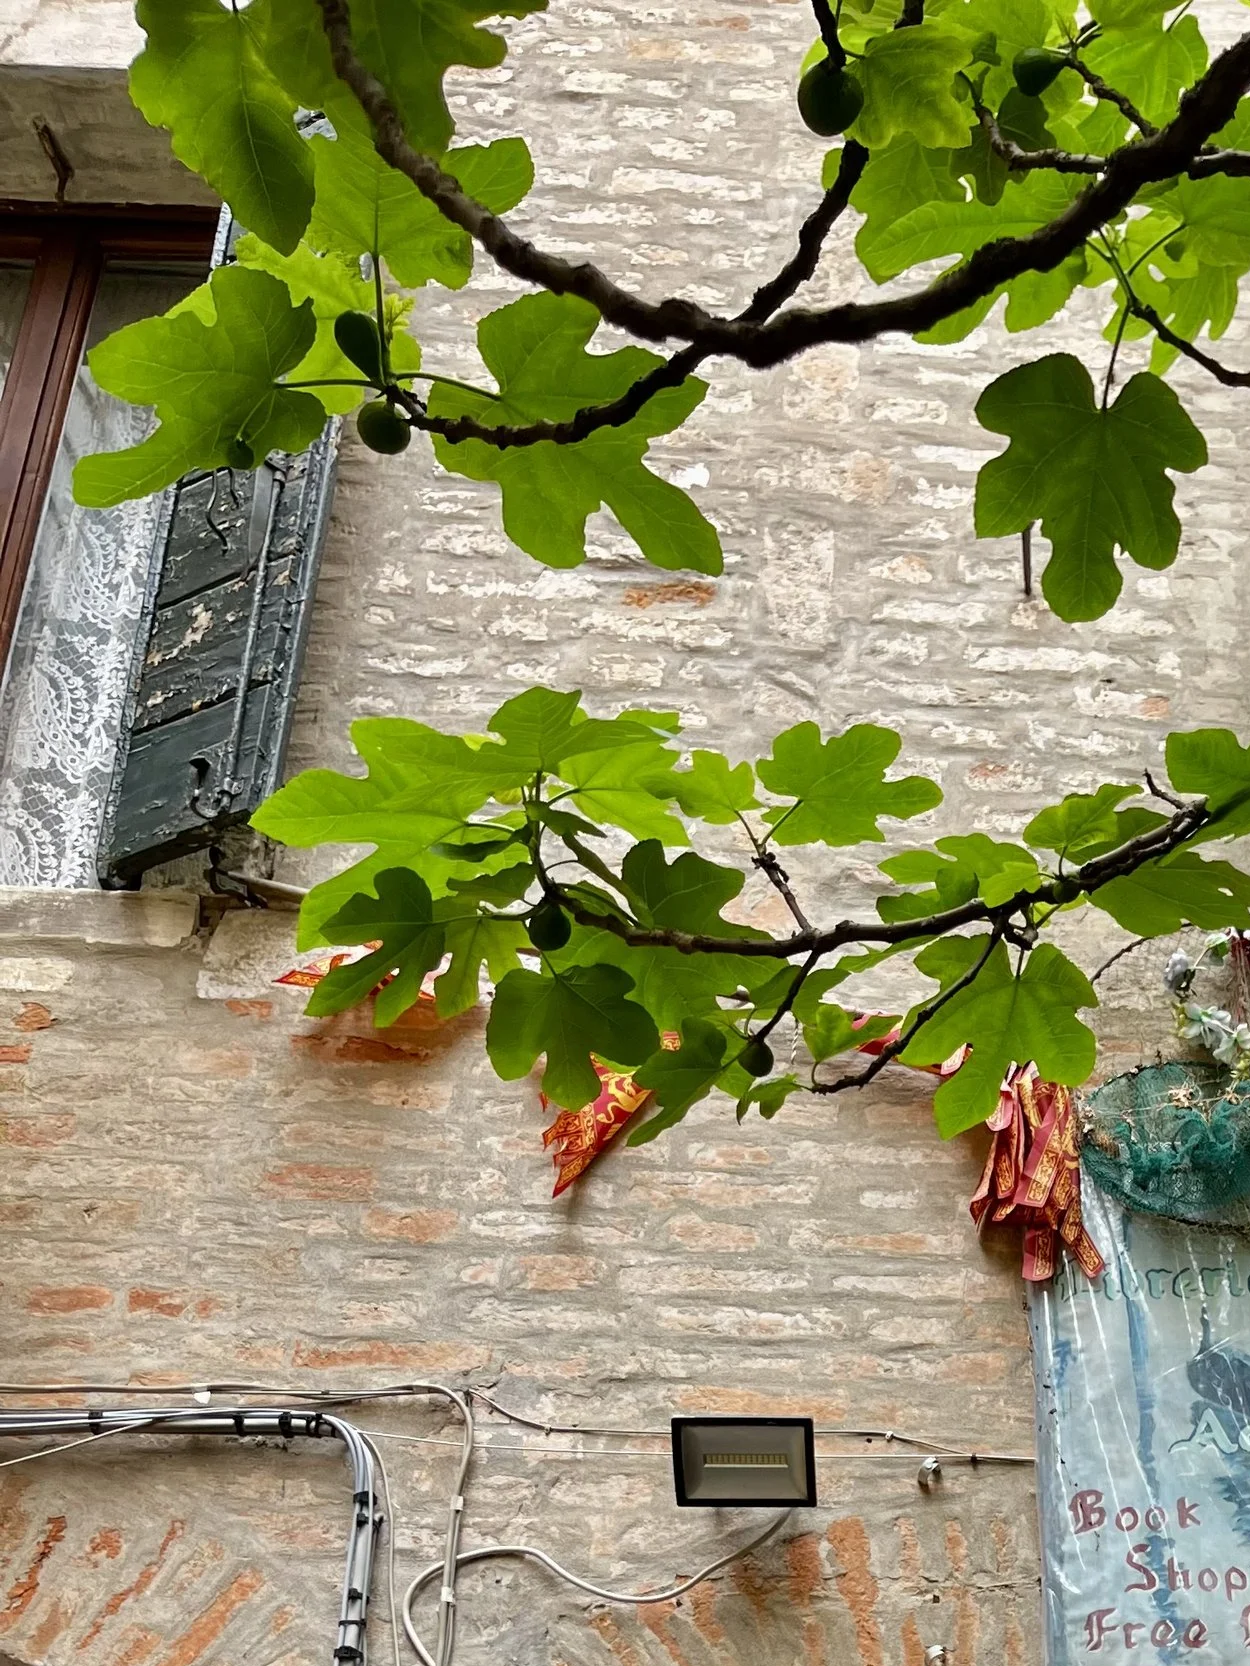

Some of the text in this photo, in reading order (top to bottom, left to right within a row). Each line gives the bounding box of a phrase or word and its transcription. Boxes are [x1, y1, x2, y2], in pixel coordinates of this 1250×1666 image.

[1068, 1489, 1200, 1536] Book
[1124, 1543, 1249, 1600] Shop
[1083, 1606, 1208, 1653] Free
